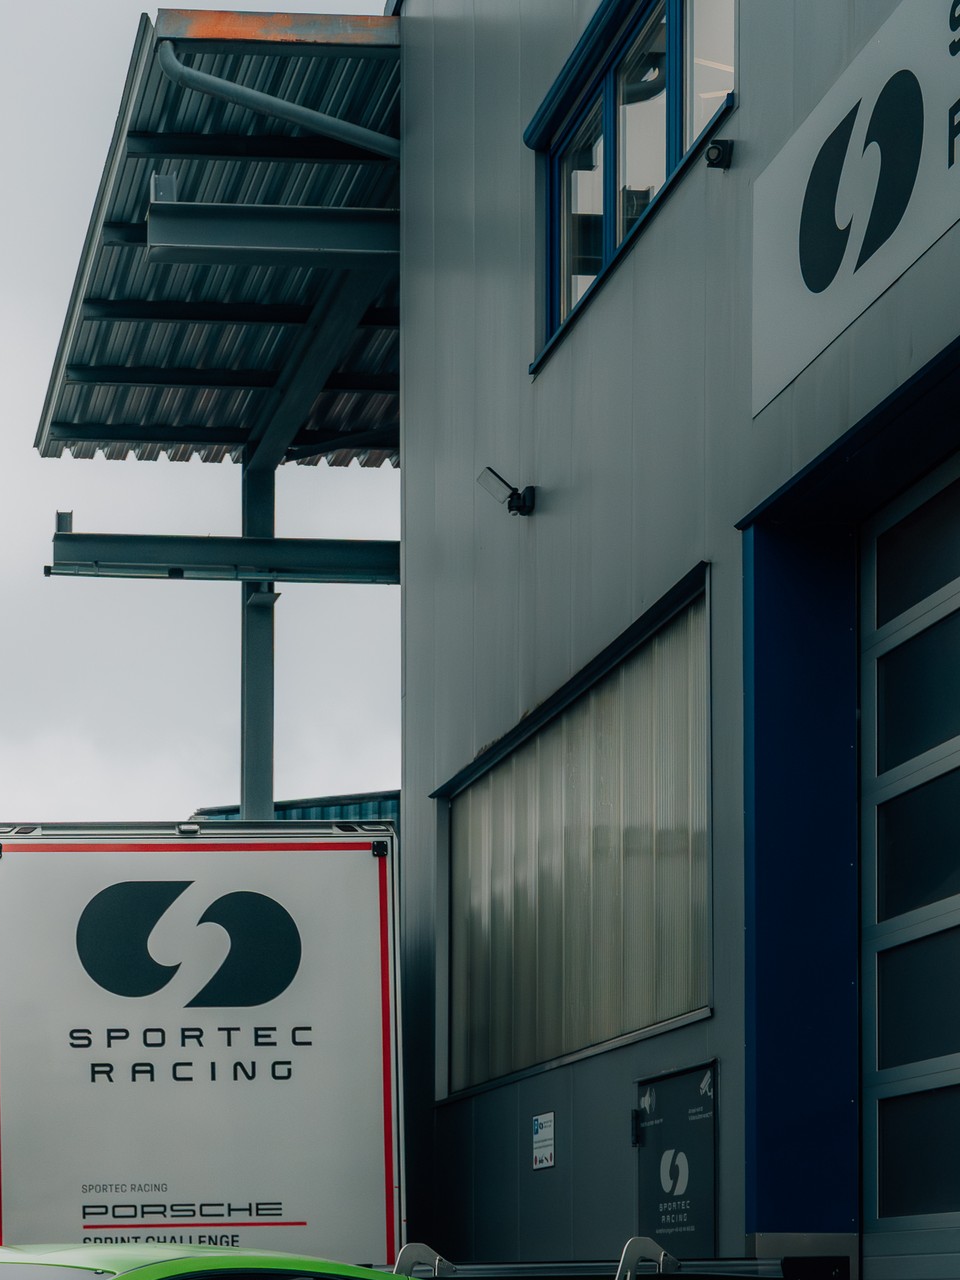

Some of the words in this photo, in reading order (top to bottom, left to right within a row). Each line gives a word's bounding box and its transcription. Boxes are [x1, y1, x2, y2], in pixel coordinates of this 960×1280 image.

[68, 1026, 313, 1048] SPORTEC
[90, 1060, 293, 1083] RACING
[81, 1184, 127, 1194] SPORTEC
[130, 1183, 168, 1193] RACING
[82, 1202, 282, 1219] PORSCHE
[658, 1200, 691, 1212] SPORTEC
[661, 1213, 688, 1224] RACING
